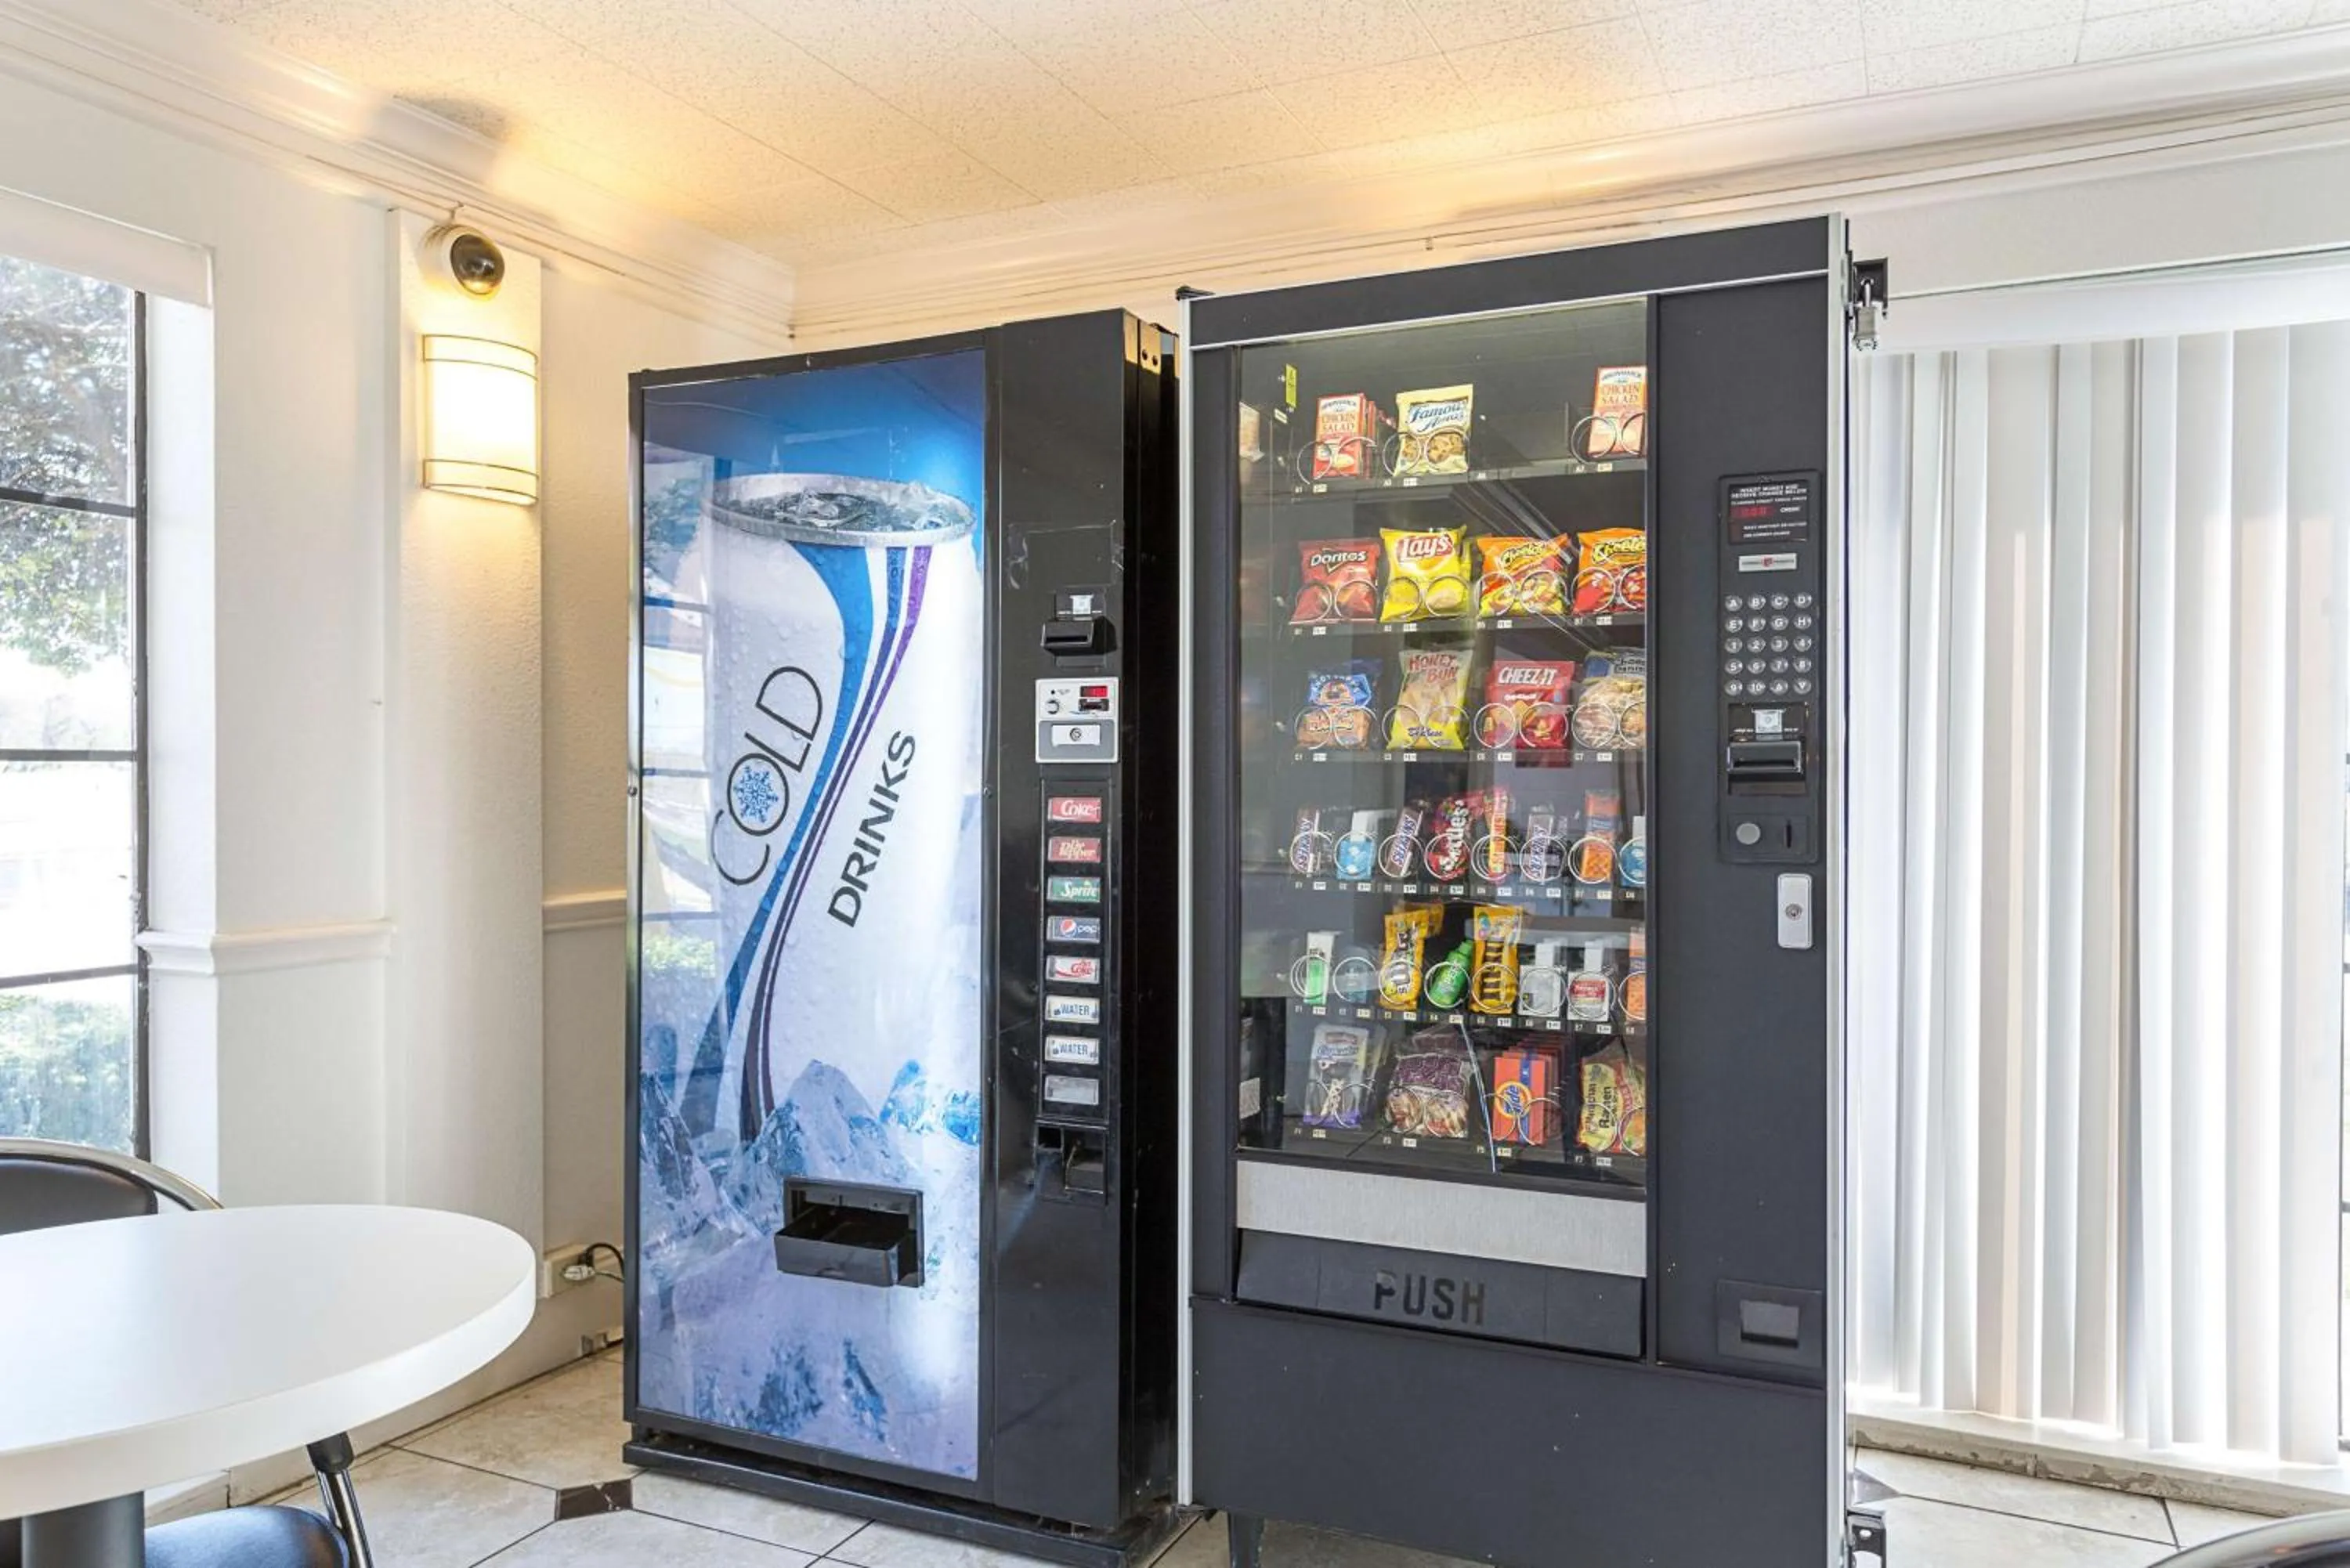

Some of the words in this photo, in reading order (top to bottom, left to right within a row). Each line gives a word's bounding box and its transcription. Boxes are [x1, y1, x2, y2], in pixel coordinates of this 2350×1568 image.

[1602, 384, 1640, 395] CHICKEN
[1602, 394, 1639, 403] SALAD
[1321, 414, 1356, 424] CHICKEN
[1408, 403, 1466, 424] Famous
[1322, 422, 1355, 432] SALAD
[1311, 550, 1367, 567] Doritos
[1409, 653, 1458, 671] HONEY
[1427, 666, 1459, 683] BUN
[710, 665, 823, 887] COLD
[1061, 799, 1100, 817] Coke
[827, 730, 916, 928] DRINKS
[1060, 879, 1098, 899] Sprite
[1061, 1003, 1090, 1017] WATER
[1059, 1043, 1088, 1056] WATER
[1373, 1270, 1487, 1326] PUSH
